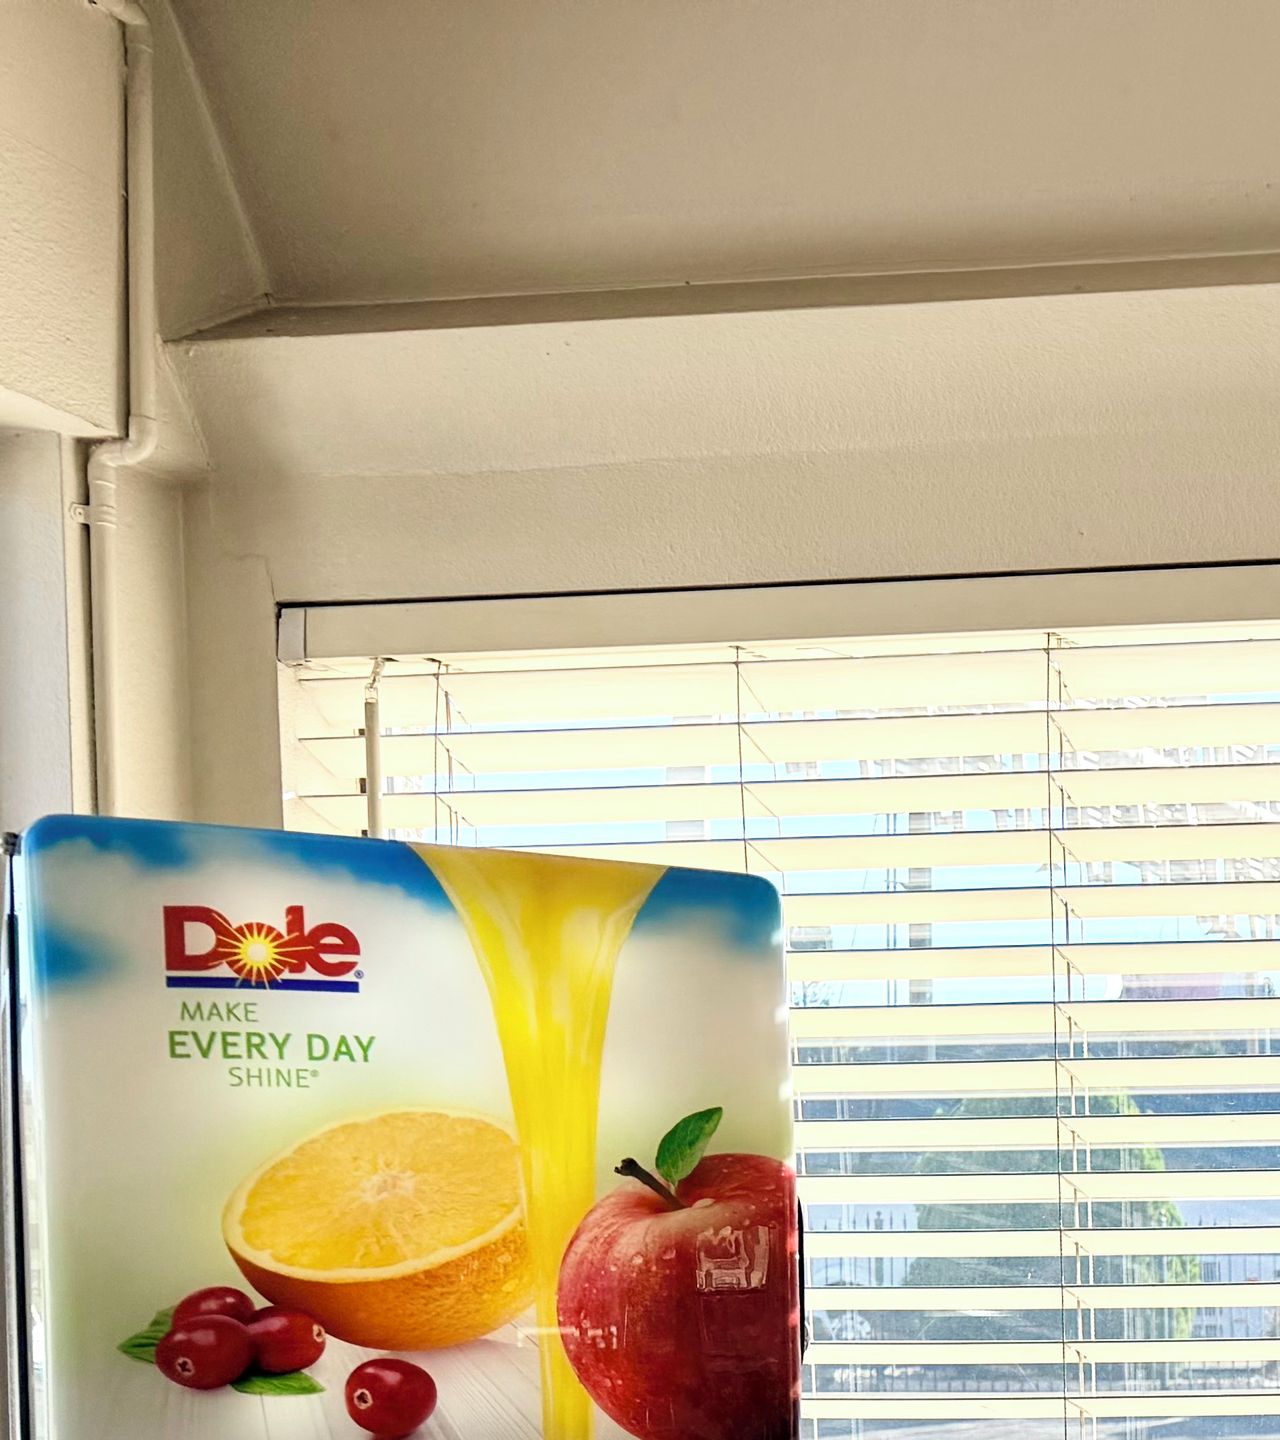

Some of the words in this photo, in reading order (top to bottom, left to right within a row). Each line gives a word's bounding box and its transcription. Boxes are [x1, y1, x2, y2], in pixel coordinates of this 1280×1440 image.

[180, 1001, 259, 1023] MAKE
[168, 1030, 292, 1060] EVERY
[306, 1033, 375, 1062] DAY
